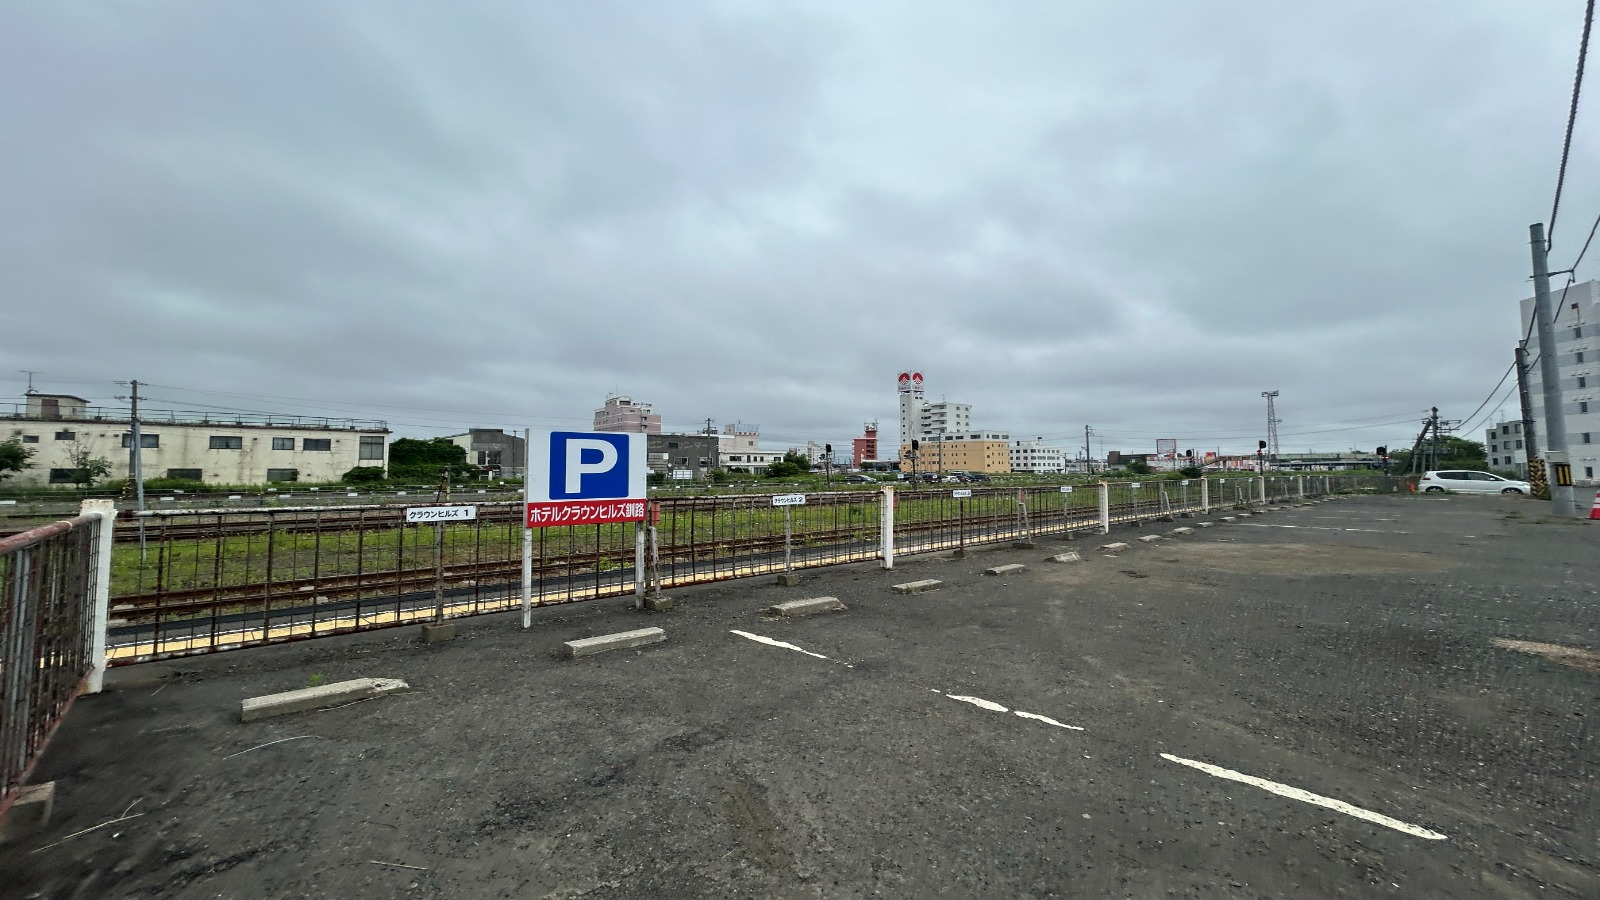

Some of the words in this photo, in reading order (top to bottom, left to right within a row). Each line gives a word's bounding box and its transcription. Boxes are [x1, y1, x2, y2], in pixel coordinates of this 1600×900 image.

[565, 438, 618, 494] P
[409, 509, 459, 519] クラウンヒルズ
[463, 509, 469, 517] 1
[530, 502, 645, 523] ホテルクラウンヒルズ釧路
